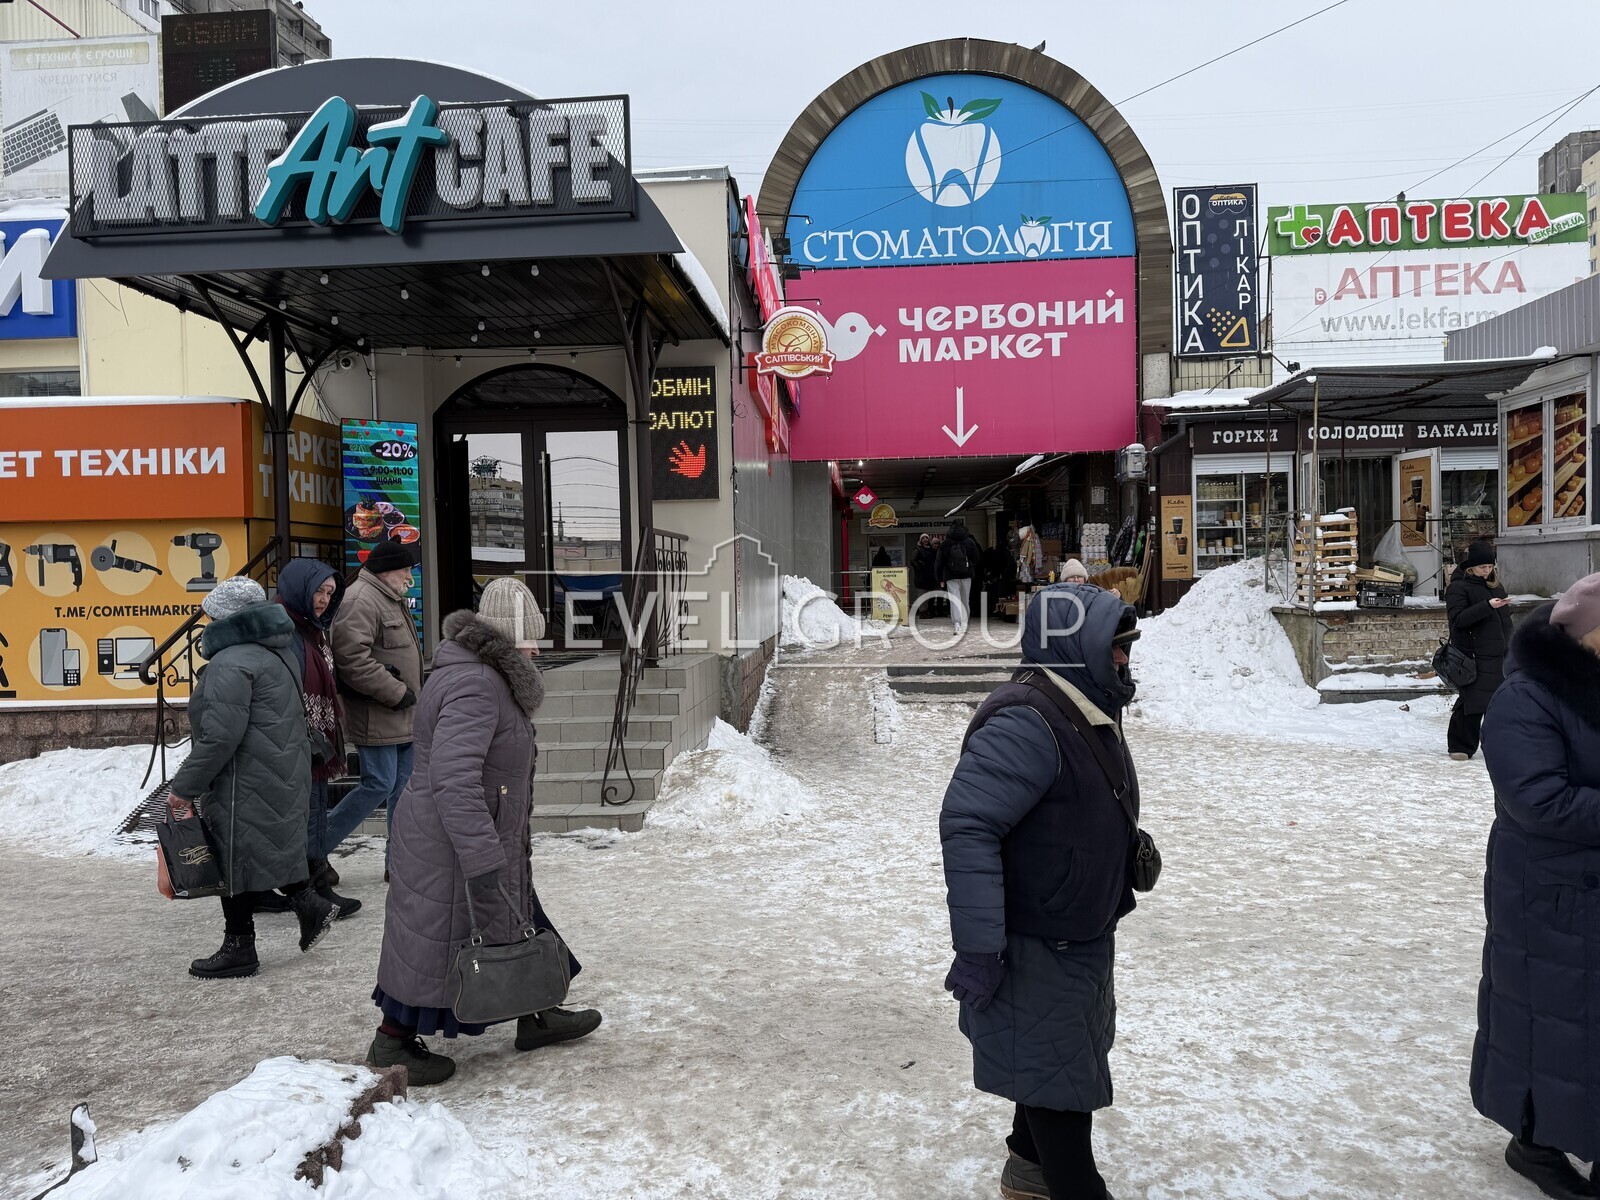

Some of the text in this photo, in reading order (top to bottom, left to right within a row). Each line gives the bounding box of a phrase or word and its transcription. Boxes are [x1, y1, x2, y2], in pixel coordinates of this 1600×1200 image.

[255, 94, 449, 236] Art
[435, 105, 613, 210] CAFE
[1327, 196, 1552, 248] АПТЕКА
[1181, 193, 1205, 352] ОПТИКА
[1234, 219, 1251, 311] ЛІКАР
[1333, 260, 1527, 301] АПТЕКА
[765, 353, 824, 364] САЛТІВСЬКИЙ
[375, 442, 414, 458] -20%
[1212, 428, 1278, 444] ГОРІХИ
[54, 447, 226, 477] ТЕХНІКИ
